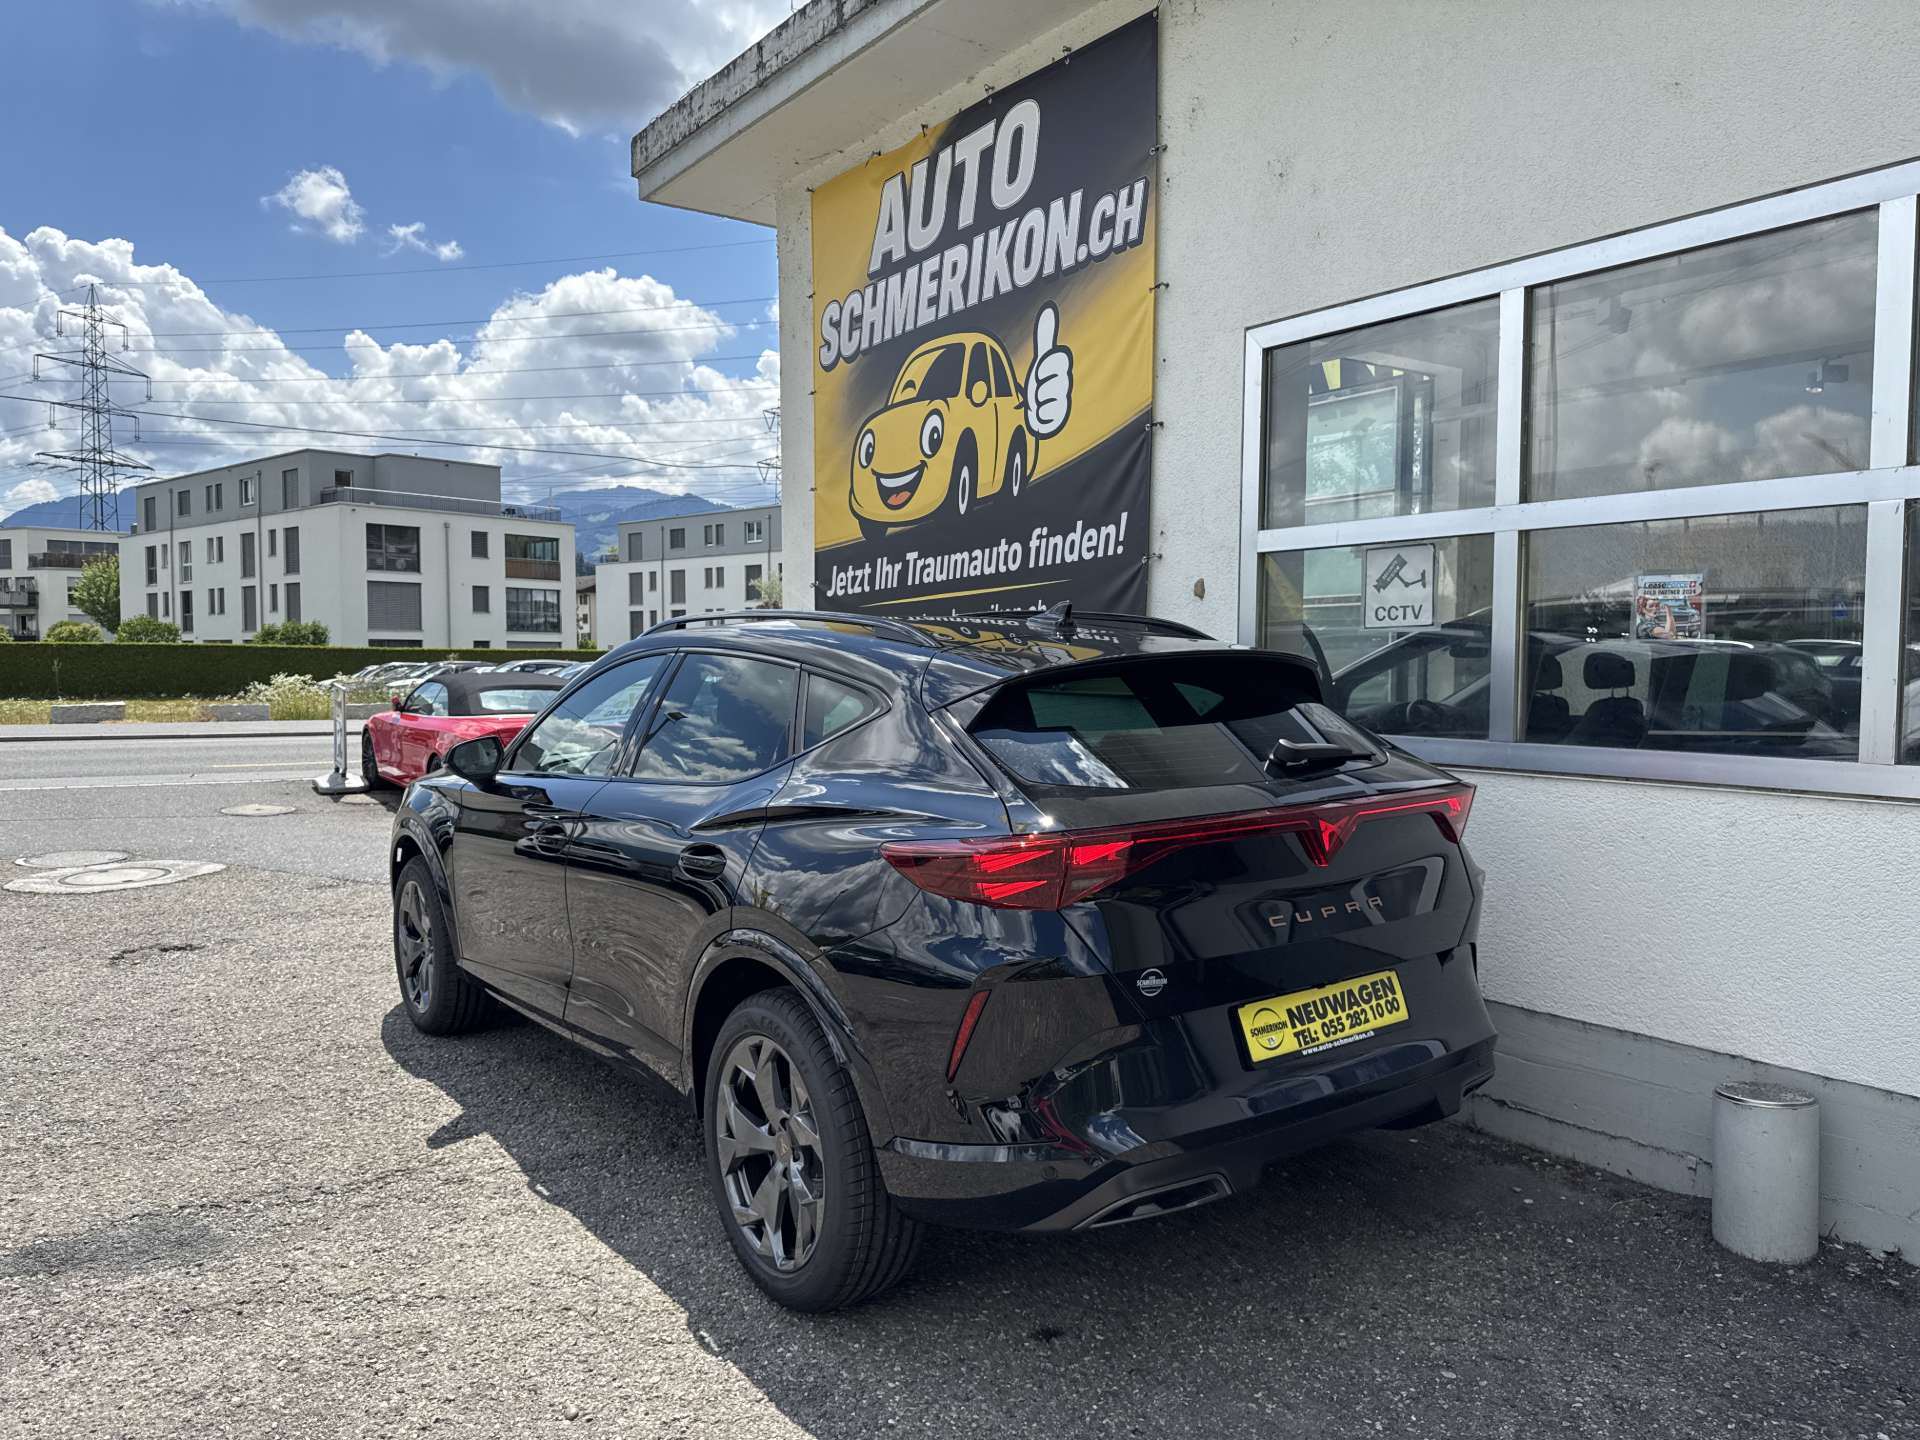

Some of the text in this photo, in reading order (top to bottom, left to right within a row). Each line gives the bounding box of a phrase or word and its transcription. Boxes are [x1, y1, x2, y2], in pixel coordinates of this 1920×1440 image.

[868, 98, 1041, 275] AUTO
[820, 177, 1148, 369] SCHMERIKON.CH
[826, 512, 1128, 598] Jetzt Ihr Traumauto finden!
[1375, 604, 1423, 621] CCTV
[1268, 896, 1383, 927] CUPRA
[1250, 1019, 1288, 1037] SCHMERIKON
[1286, 976, 1397, 1029] NEUWAGEN
[1293, 1028, 1320, 1048] TEL:
[1321, 1016, 1343, 1038] 055
[1346, 1008, 1370, 1029] 282
[1371, 1002, 1384, 1020] 10
[1386, 997, 1400, 1014] 00
